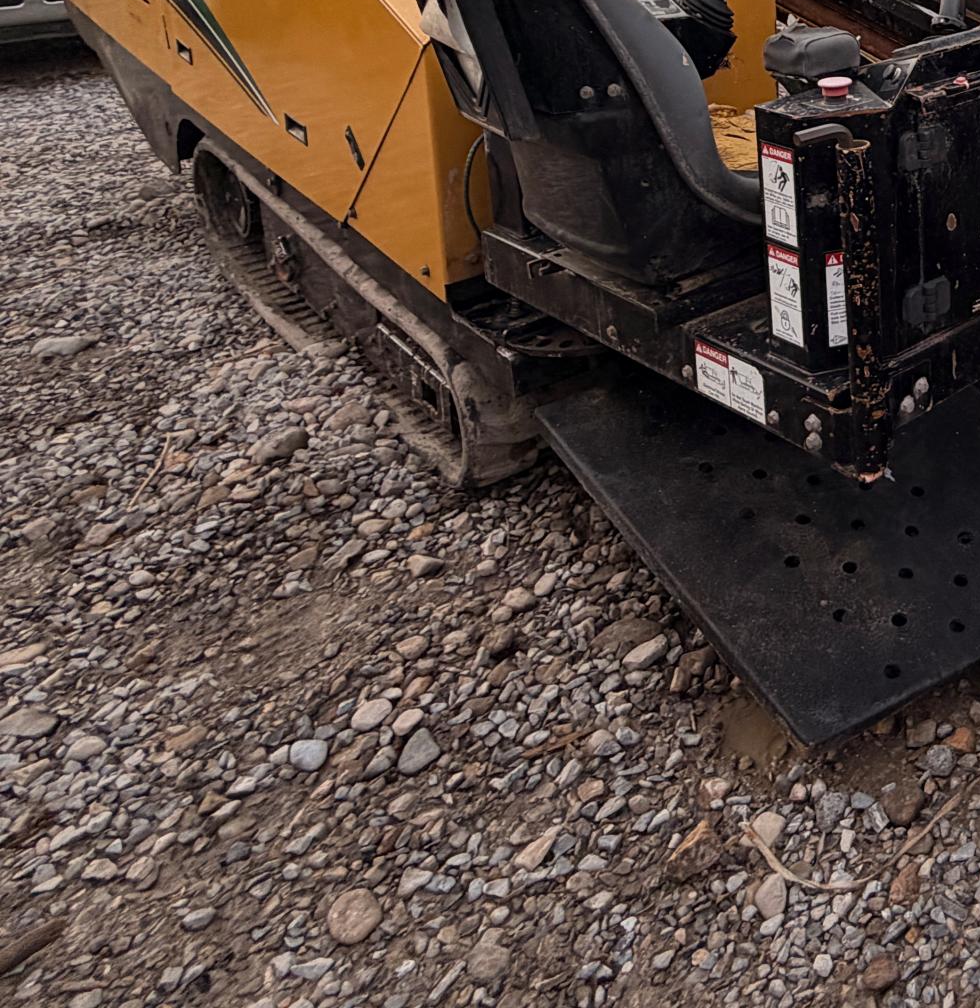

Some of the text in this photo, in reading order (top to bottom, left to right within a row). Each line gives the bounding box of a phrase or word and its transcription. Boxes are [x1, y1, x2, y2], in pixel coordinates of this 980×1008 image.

[769, 147, 792, 161] DANGER
[775, 250, 798, 266] DANGER
[702, 344, 728, 364] DANGER
